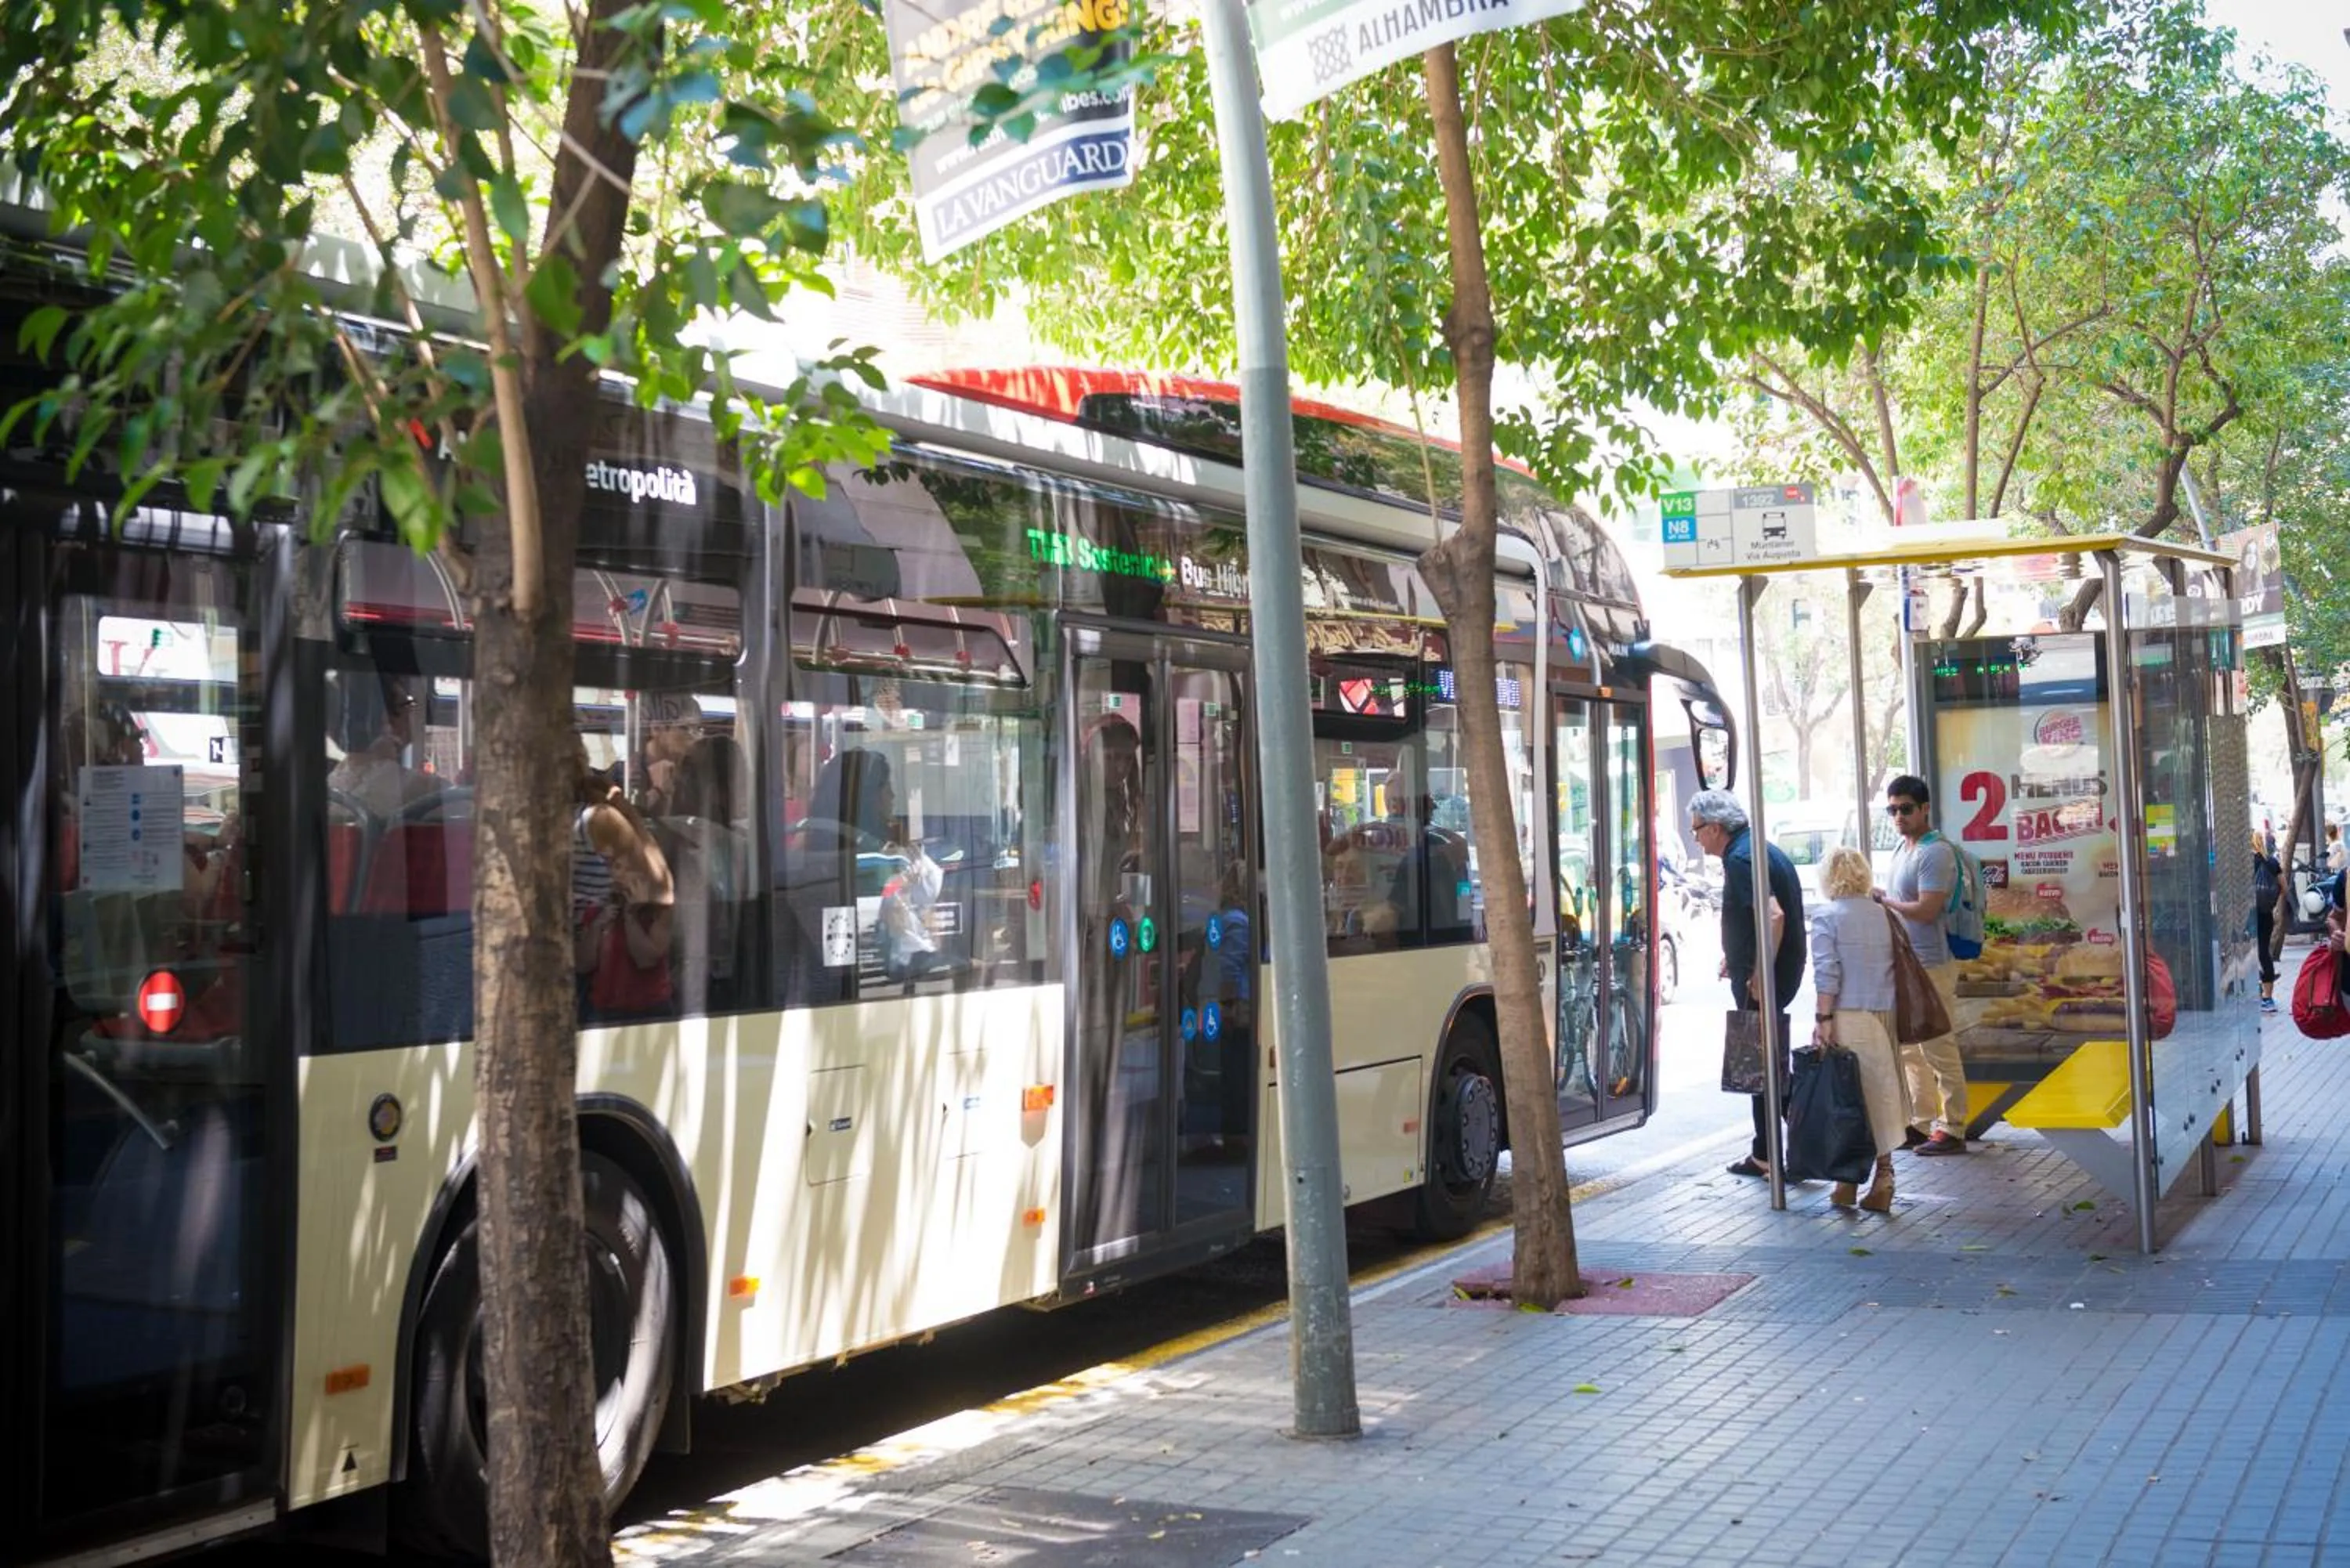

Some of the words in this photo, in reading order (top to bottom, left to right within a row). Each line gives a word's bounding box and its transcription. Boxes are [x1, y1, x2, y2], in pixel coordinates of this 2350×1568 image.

[1358, 0, 1510, 55] ALHAMB
[585, 459, 696, 506] etropolità
[1663, 497, 1694, 514] V13
[1668, 520, 1690, 534] N8
[1961, 771, 2008, 841] 2
